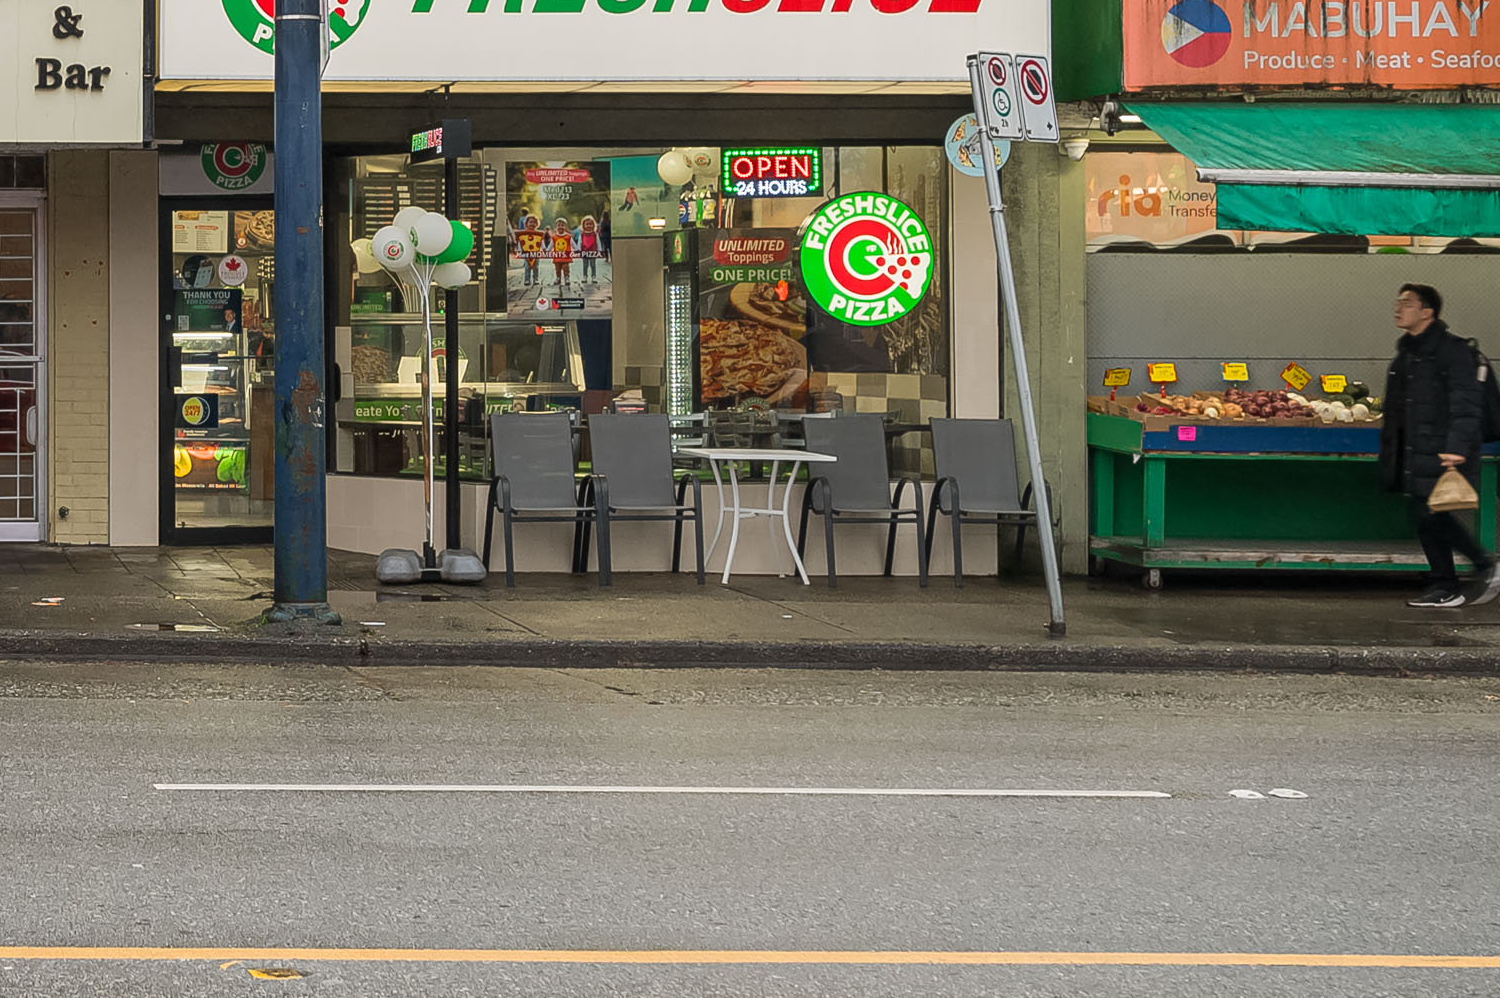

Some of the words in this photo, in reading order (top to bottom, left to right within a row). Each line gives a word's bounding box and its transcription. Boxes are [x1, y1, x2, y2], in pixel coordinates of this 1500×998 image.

[52, 6, 84, 40] &
[1243, 1, 1490, 37] MABUHAY
[1244, 50, 1334, 69] Produce
[1356, 50, 1411, 69] Meat
[35, 57, 111, 91] Bar
[732, 156, 810, 178] OPEN
[216, 176, 252, 188] PIZZA
[736, 181, 755, 196] 24
[759, 180, 808, 195] HOURS
[1098, 174, 1161, 217] ria
[1169, 189, 1216, 205] Money
[805, 196, 929, 252] FRESHSLICE
[718, 239, 785, 252] UNLIMITED
[728, 252, 774, 264] Toppings
[713, 269, 744, 281] ONE
[748, 269, 791, 281] PRICE!
[183, 291, 211, 299] THANK
[213, 291, 231, 299] YOU
[828, 293, 906, 321] PIZZA
